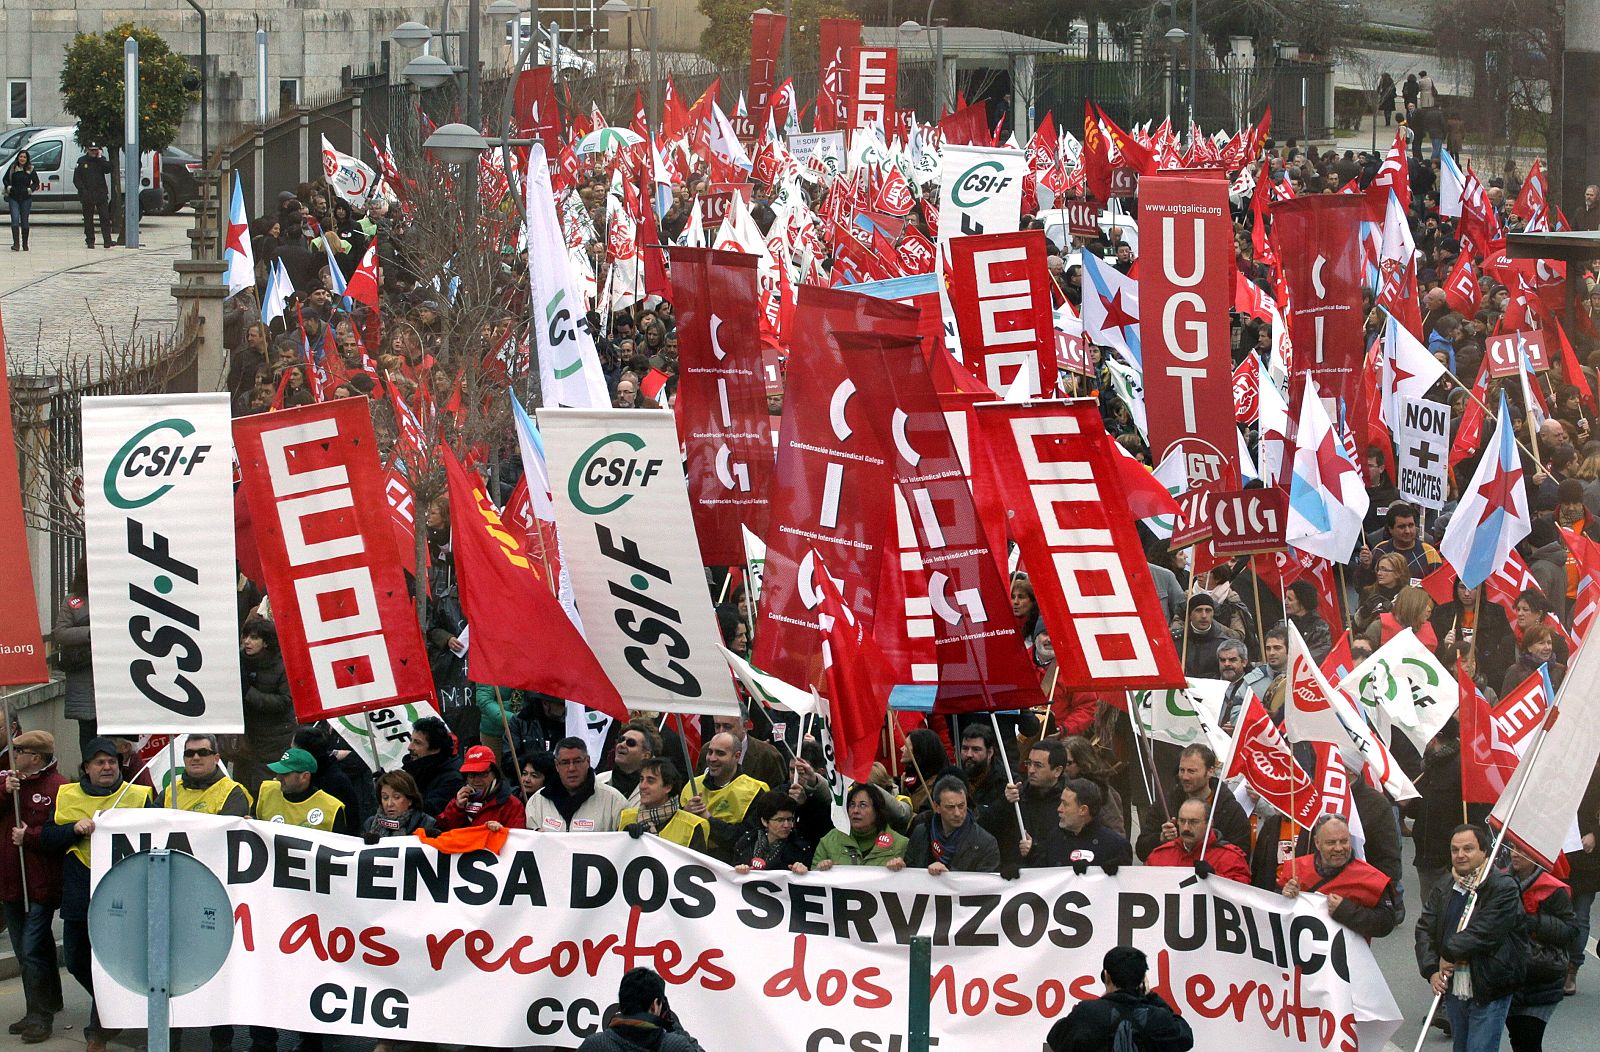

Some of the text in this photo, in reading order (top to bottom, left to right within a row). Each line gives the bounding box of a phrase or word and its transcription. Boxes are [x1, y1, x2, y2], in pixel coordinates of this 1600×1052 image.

[1070, 204, 1096, 228] CIG
[1145, 203, 1222, 216] www.ugtgalicia.org
[1162, 216, 1209, 434] UGT
[1405, 402, 1446, 437] NON
[790, 440, 885, 465] Confederación Intersindical Galega
[942, 468, 962, 478] Galega
[1401, 467, 1442, 502] RECORTES
[1215, 497, 1278, 537] CIG
[779, 524, 874, 550] Confederación Intersindical Galega
[1009, 415, 1160, 679] CCOO
[260, 417, 398, 711] CCOO
[932, 548, 989, 564] Intersindical Galega
[768, 611, 806, 626] Confederación
[961, 630, 996, 642] Intersindical
[996, 627, 1015, 637] Galega
[225, 829, 548, 907] DEFENSA
[569, 852, 718, 920] DOS
[735, 879, 1094, 949] SERVIZOS
[279, 913, 400, 967] aos
[425, 904, 737, 991] recortes
[762, 932, 893, 1009] dos
[309, 982, 410, 1029] CIG
